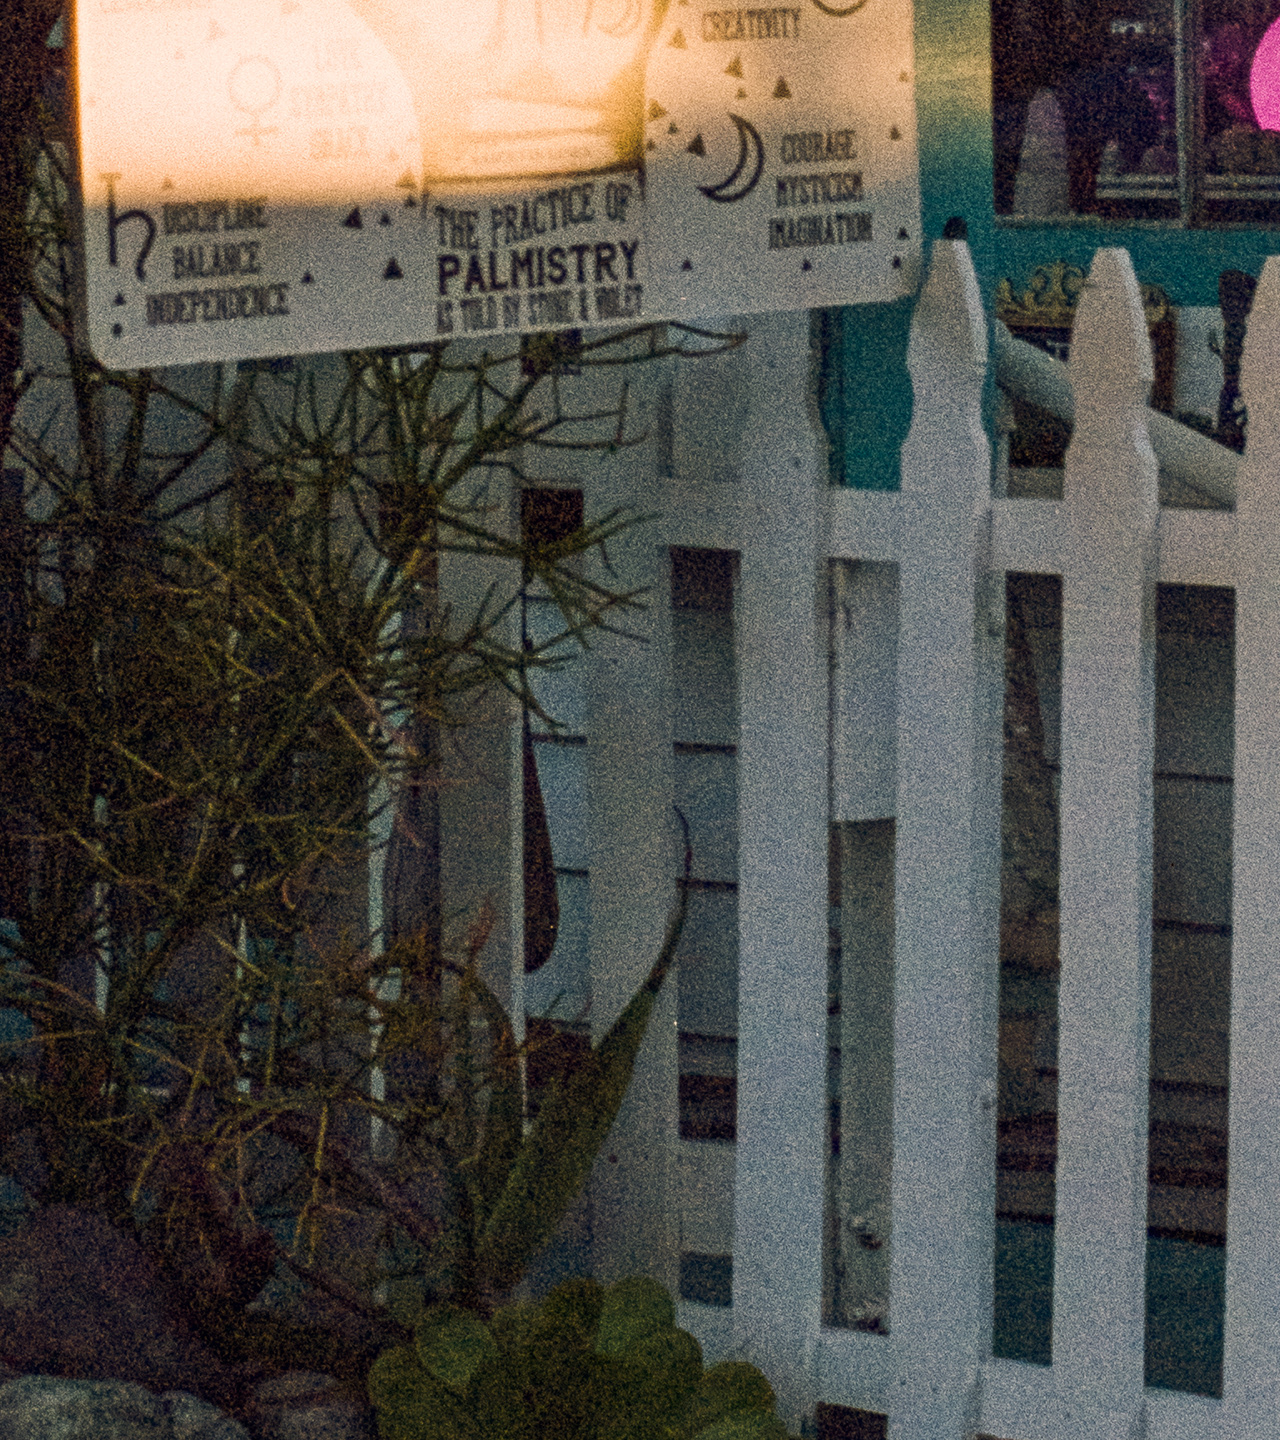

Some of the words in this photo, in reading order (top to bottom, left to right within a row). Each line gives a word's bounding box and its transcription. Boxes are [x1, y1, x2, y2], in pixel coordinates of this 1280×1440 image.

[701, 7, 800, 41] CREATIVITY
[781, 129, 857, 164] COURAGE
[776, 172, 863, 208] MYSTICISM
[163, 196, 268, 235] DISCIPLINE
[435, 207, 478, 250] THE
[490, 184, 598, 243] PRACTICE
[606, 180, 634, 222] OF
[769, 212, 872, 249] IMAGINATION
[173, 241, 260, 279] BALANCE
[437, 241, 639, 296] PALMISTRY
[147, 282, 290, 325] INDEPENDENCE
